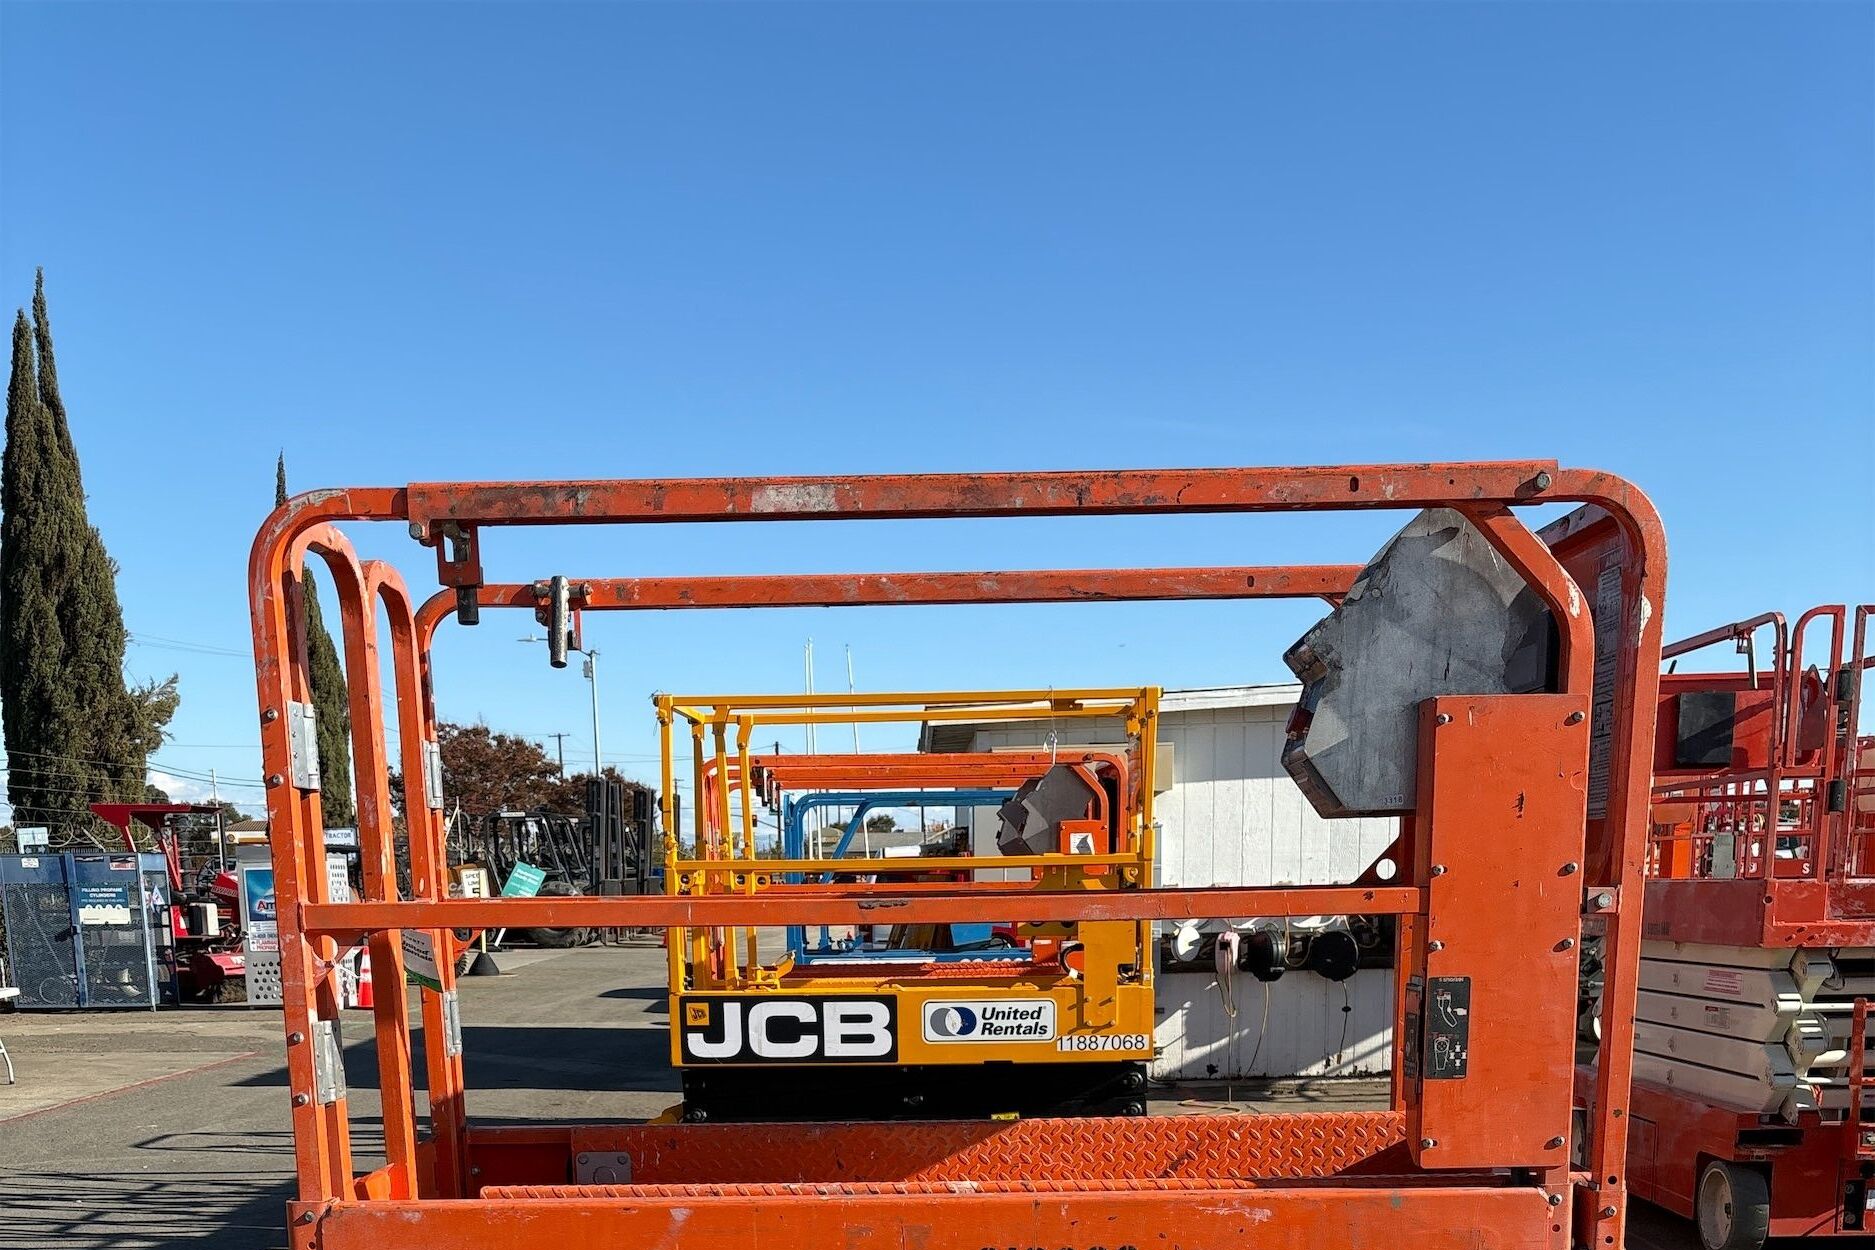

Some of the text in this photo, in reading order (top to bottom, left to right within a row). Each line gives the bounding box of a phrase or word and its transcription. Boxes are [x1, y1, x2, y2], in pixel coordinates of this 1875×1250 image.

[981, 1006, 1043, 1021] United
[687, 1001, 893, 1058] JCB
[980, 1020, 1048, 1037] Rentals
[1057, 1034, 1145, 1051] 11887068
